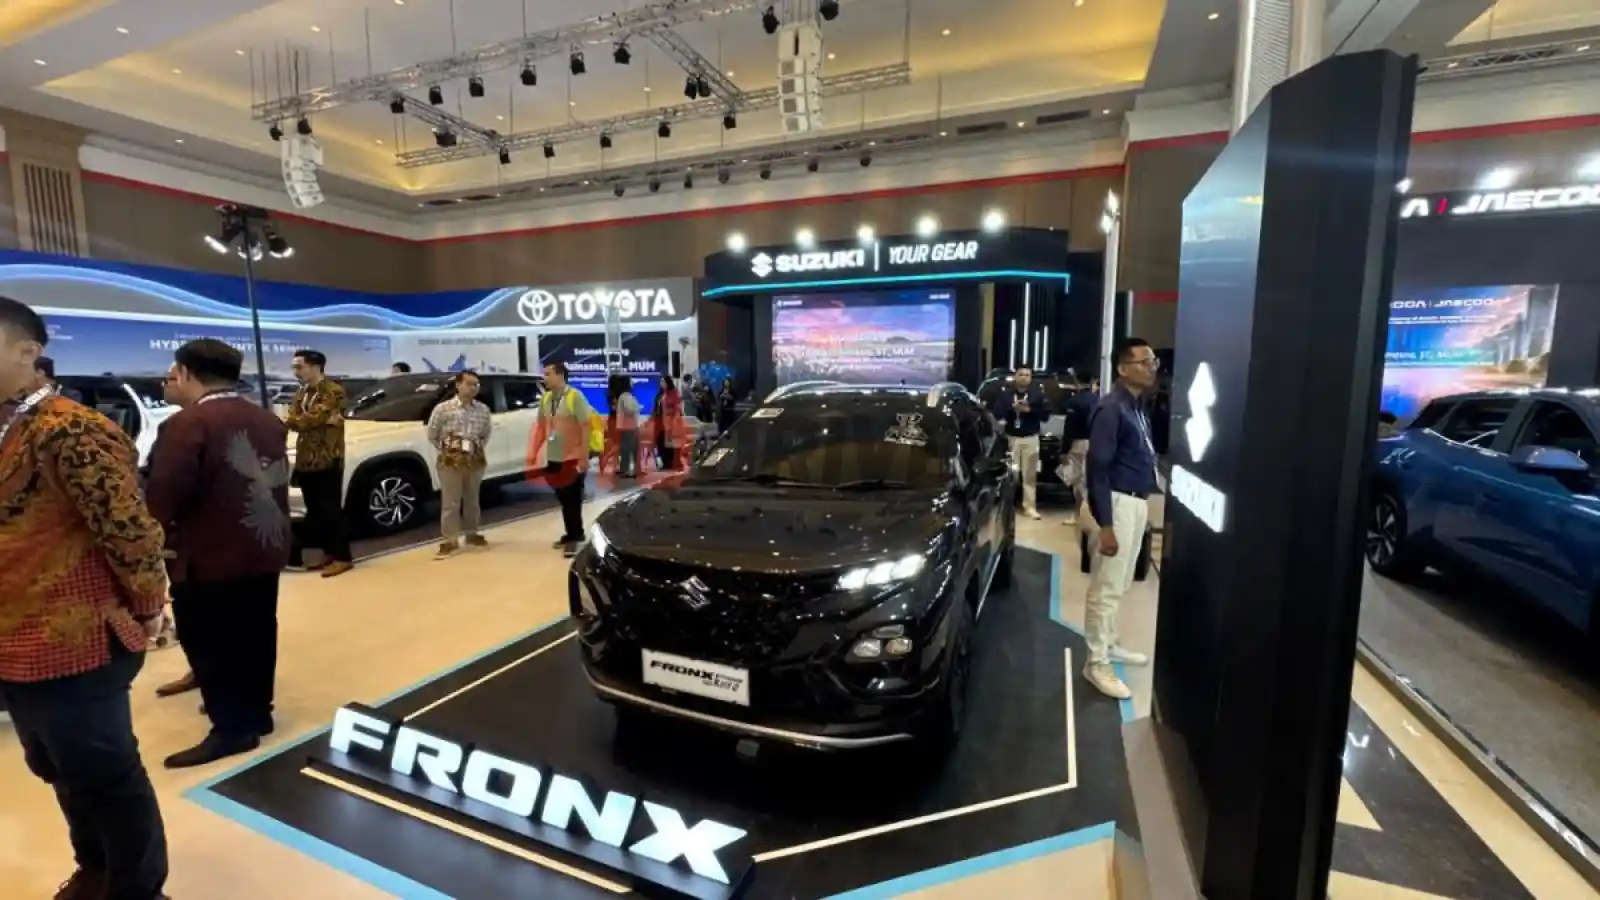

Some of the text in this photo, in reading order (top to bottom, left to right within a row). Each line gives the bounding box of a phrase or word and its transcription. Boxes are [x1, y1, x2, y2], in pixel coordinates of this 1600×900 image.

[776, 250, 865, 273] SUZUKI
[889, 241, 979, 264] YOUR GEAR
[558, 287, 676, 321] TOYOTA
[650, 660, 714, 680] FRONX
[329, 706, 748, 885] FRONX
